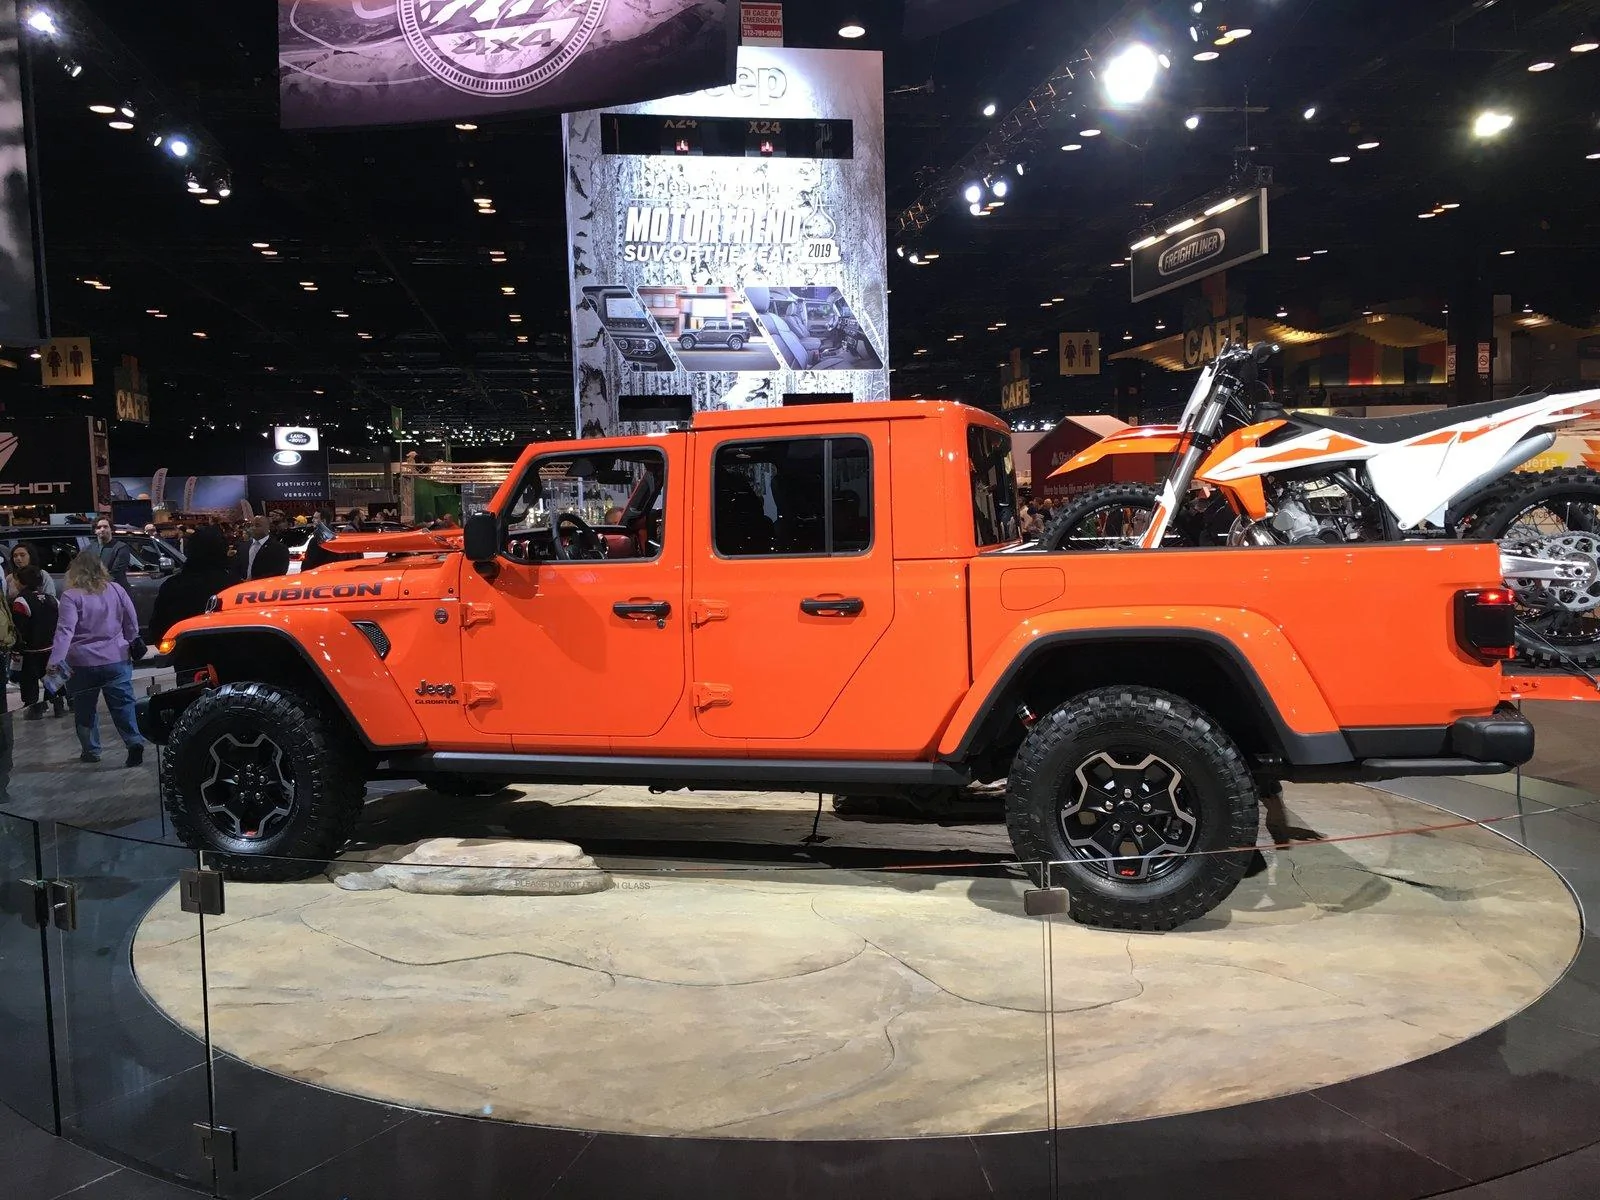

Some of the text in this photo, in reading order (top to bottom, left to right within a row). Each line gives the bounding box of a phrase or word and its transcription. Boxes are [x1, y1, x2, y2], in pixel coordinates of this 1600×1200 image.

[742, 16, 781, 24] EMERGENCY
[749, 120, 782, 134] X24
[623, 244, 665, 262] SUV
[668, 245, 700, 263] OF
[700, 245, 740, 263] THE
[808, 243, 832, 258] 2019
[1164, 235, 1219, 270] FREIGHTLINER
[1184, 314, 1246, 365] CAFE
[1002, 378, 1031, 410] CAFE
[116, 389, 149, 421] CAFE
[234, 582, 383, 605] RUBICON
[415, 680, 457, 698] Jeep
[515, 879, 546, 887] PLEASE
[563, 880, 580, 889] NOT
[622, 882, 651, 890] GLASS
